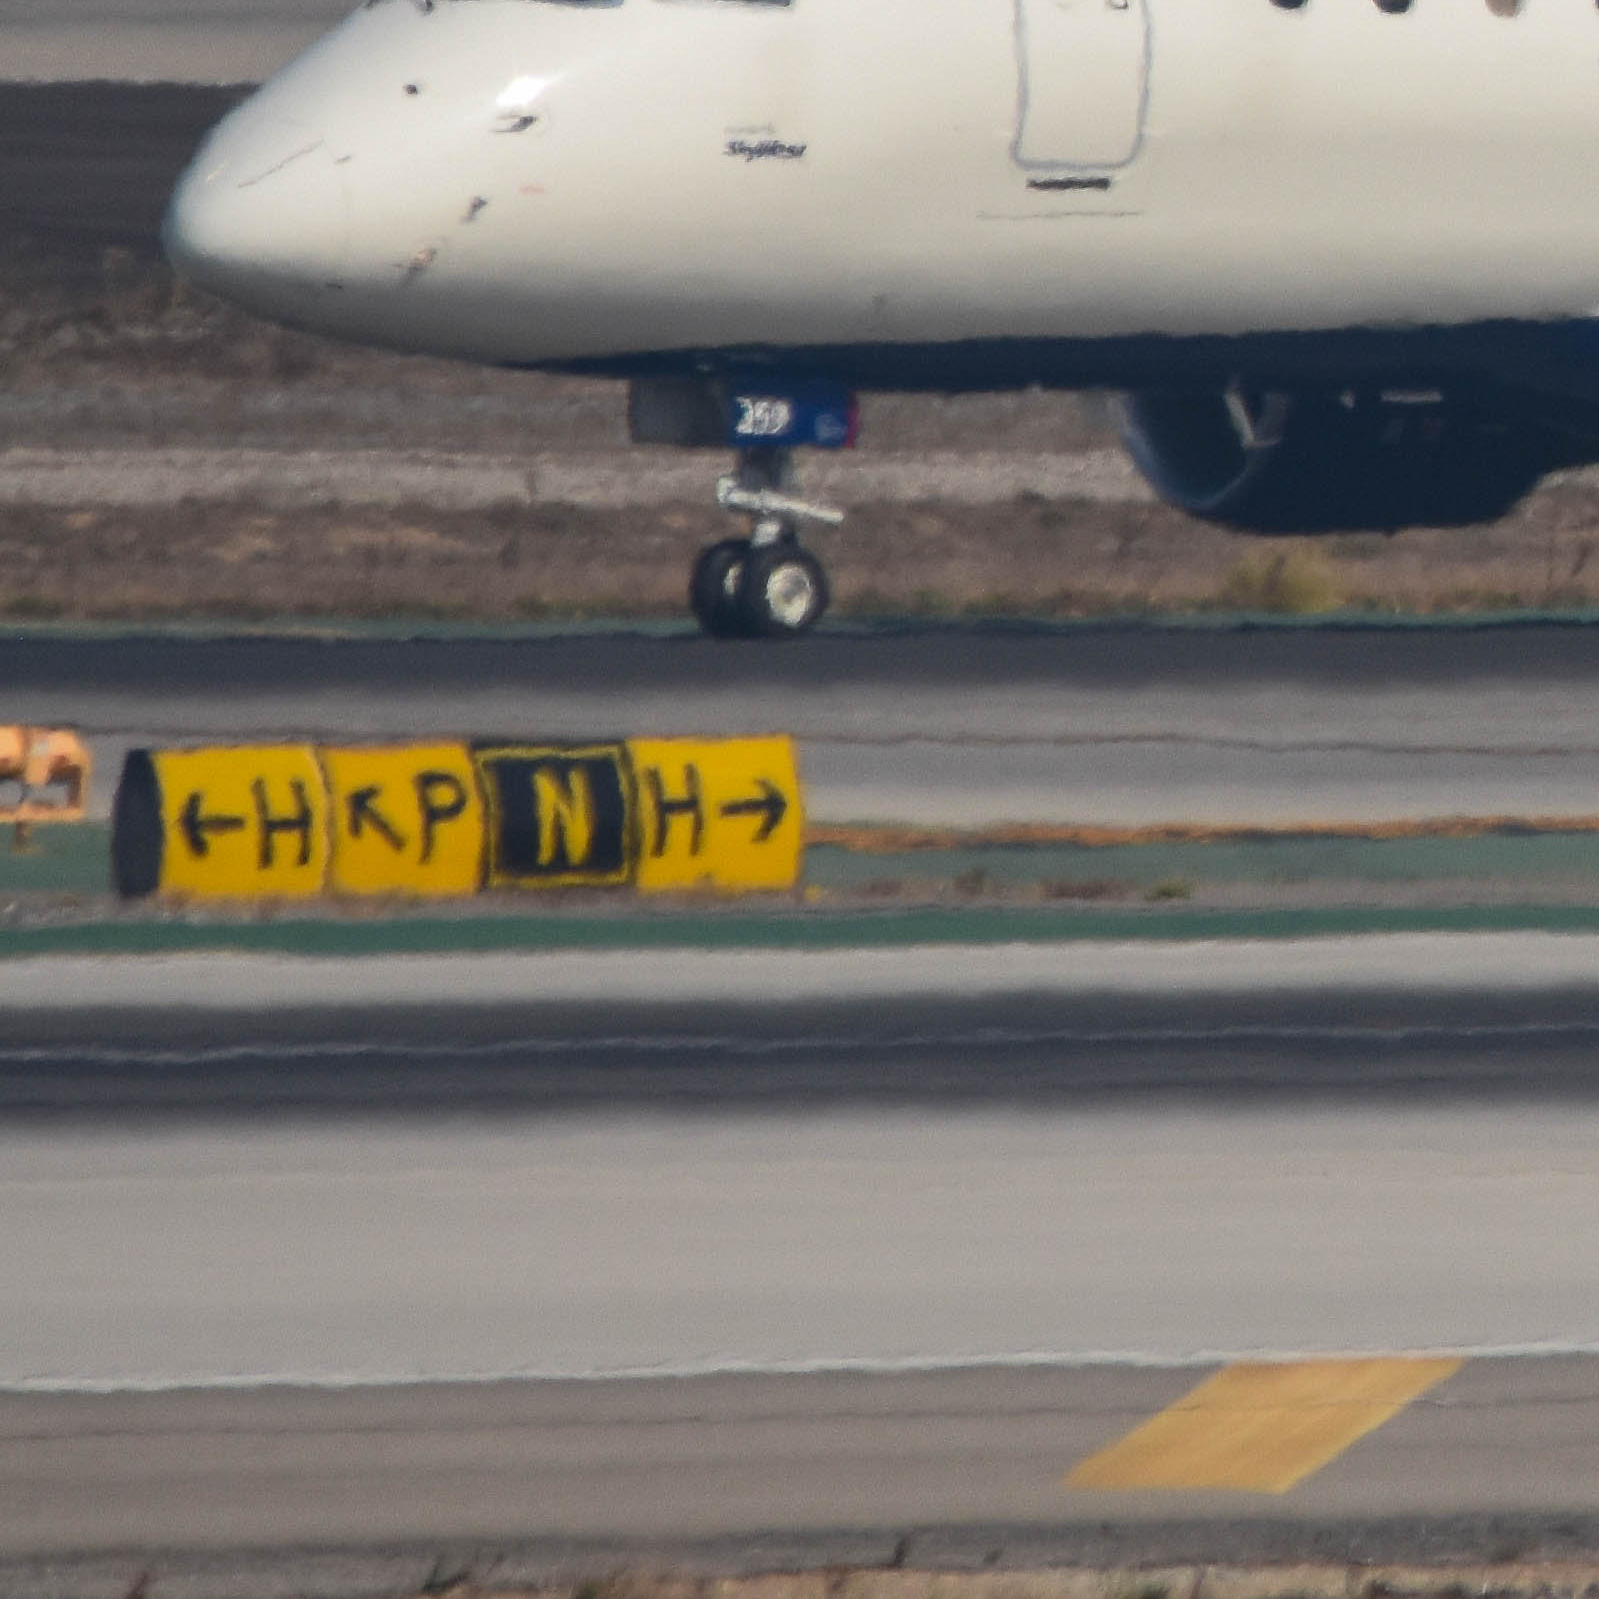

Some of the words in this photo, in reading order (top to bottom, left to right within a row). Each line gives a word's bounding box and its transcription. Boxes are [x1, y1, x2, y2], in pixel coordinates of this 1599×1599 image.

[252, 776, 311, 869] H
[416, 769, 467, 865] P
[533, 765, 598, 866] N
[643, 762, 704, 859] H
